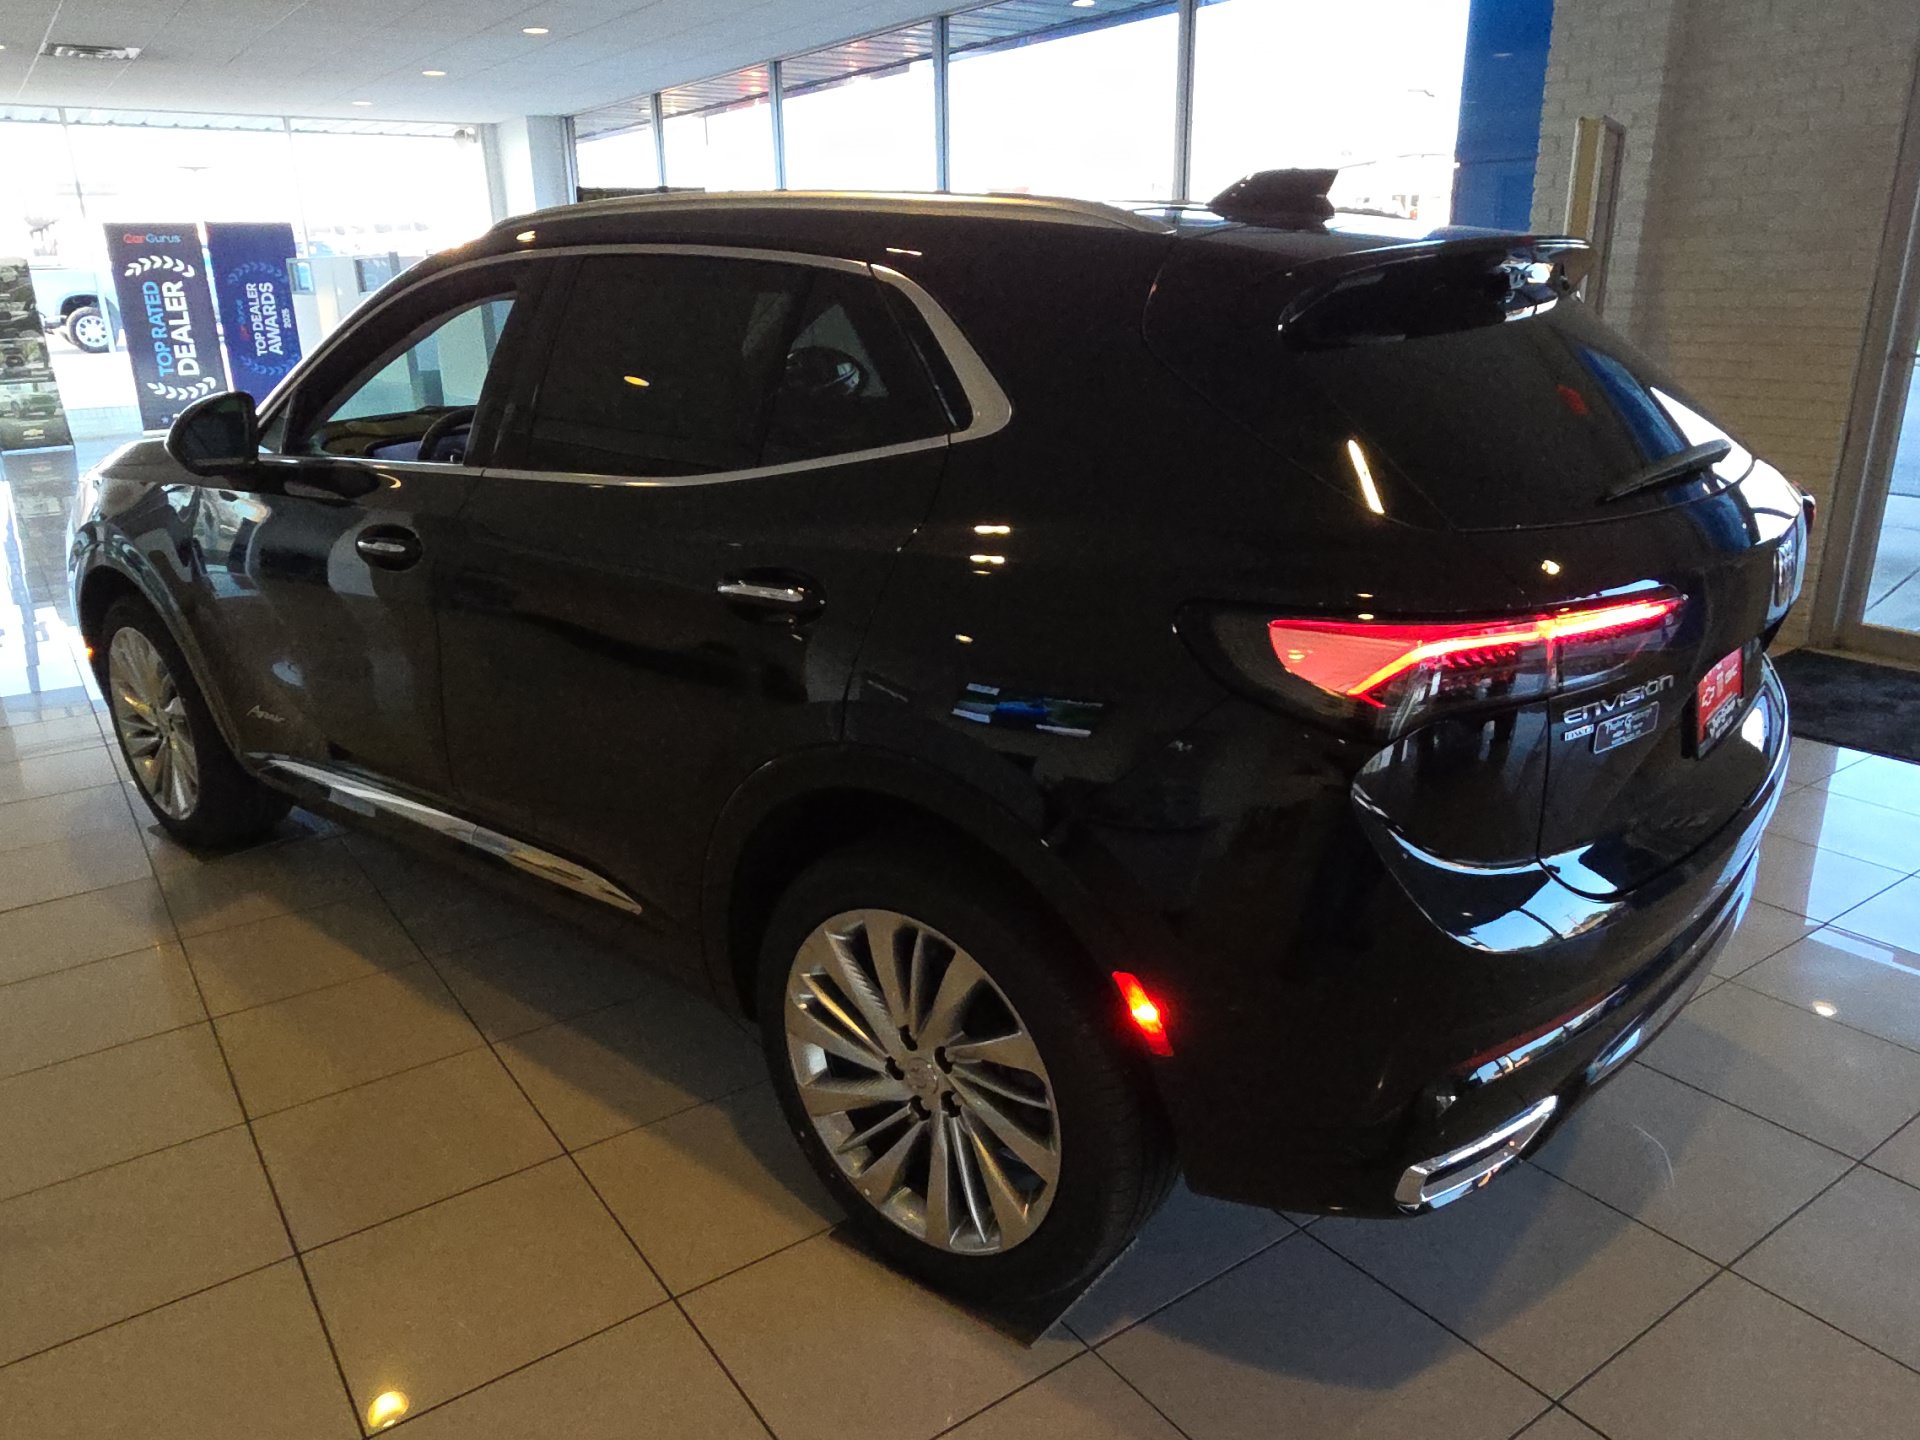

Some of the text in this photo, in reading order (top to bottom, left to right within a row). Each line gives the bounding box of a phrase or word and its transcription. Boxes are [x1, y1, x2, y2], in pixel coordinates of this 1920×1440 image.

[123, 233, 182, 244] CarGurus
[142, 281, 175, 378] TOP RATED
[161, 280, 200, 377] DEALER
[246, 282, 268, 357] TOP DEALER
[259, 282, 284, 355] AWARDS
